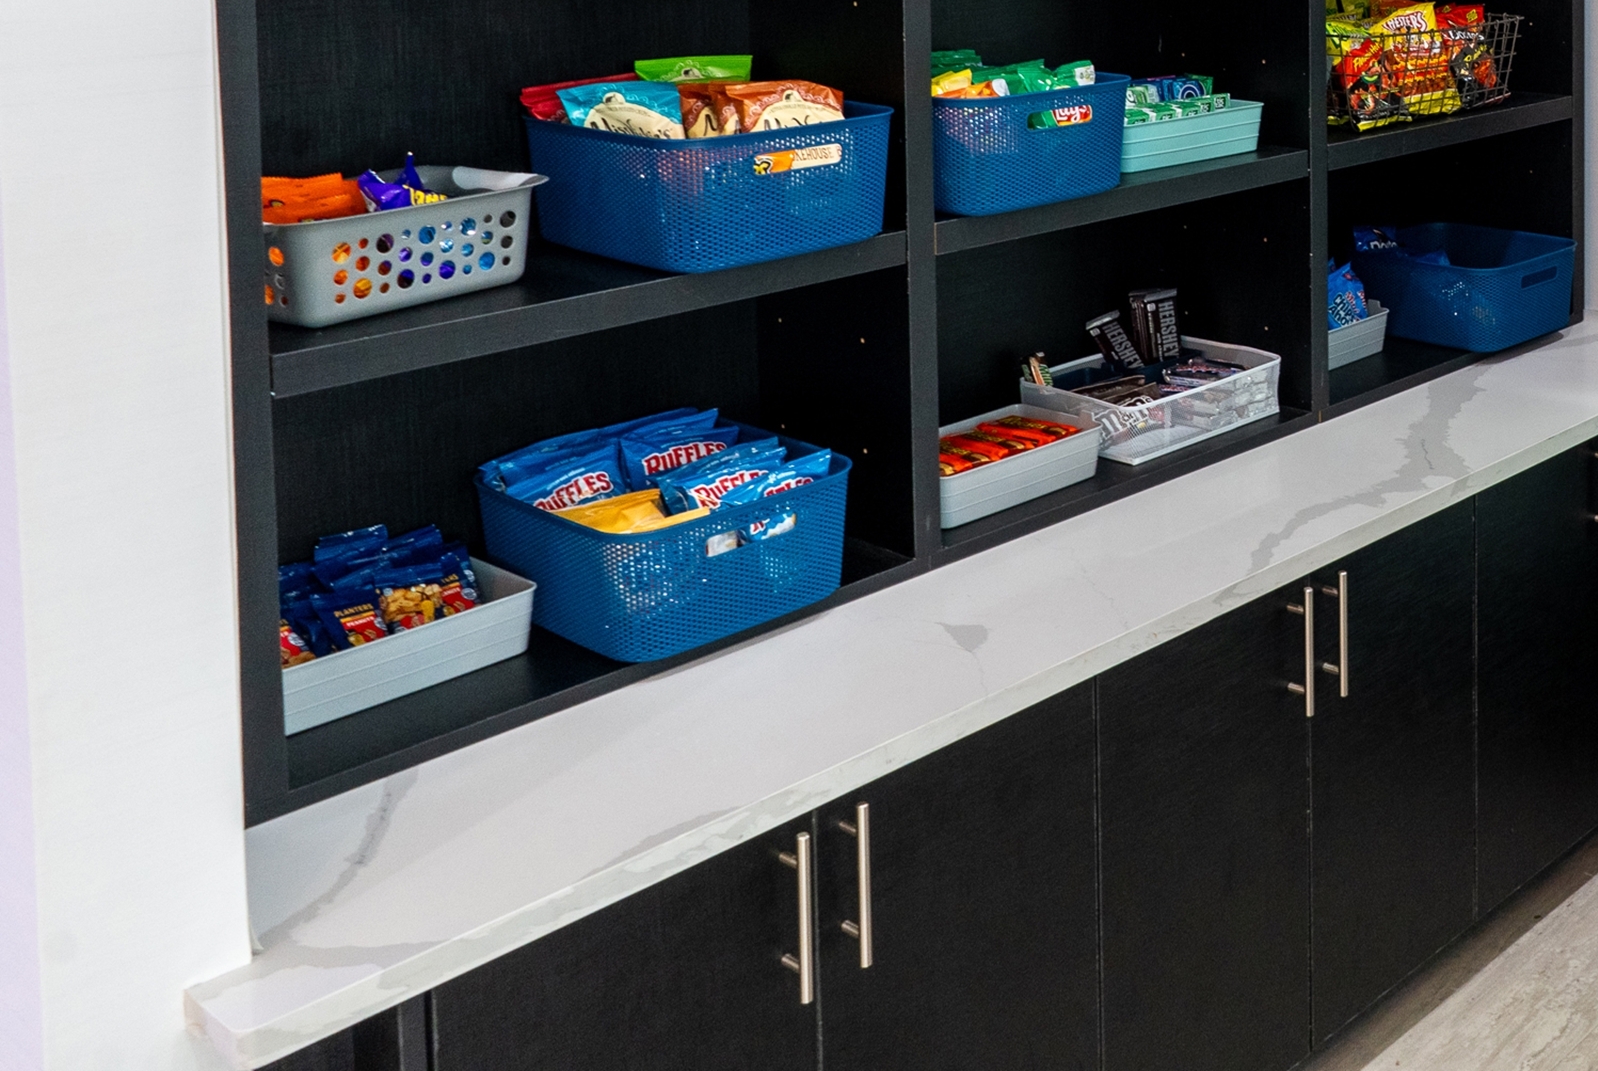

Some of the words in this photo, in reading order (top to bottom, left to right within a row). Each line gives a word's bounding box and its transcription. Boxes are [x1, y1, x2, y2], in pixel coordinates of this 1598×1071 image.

[1158, 300, 1180, 357] HERSHEY
[642, 442, 727, 476] RUFFLES
[334, 603, 374, 618] PLANTERS
